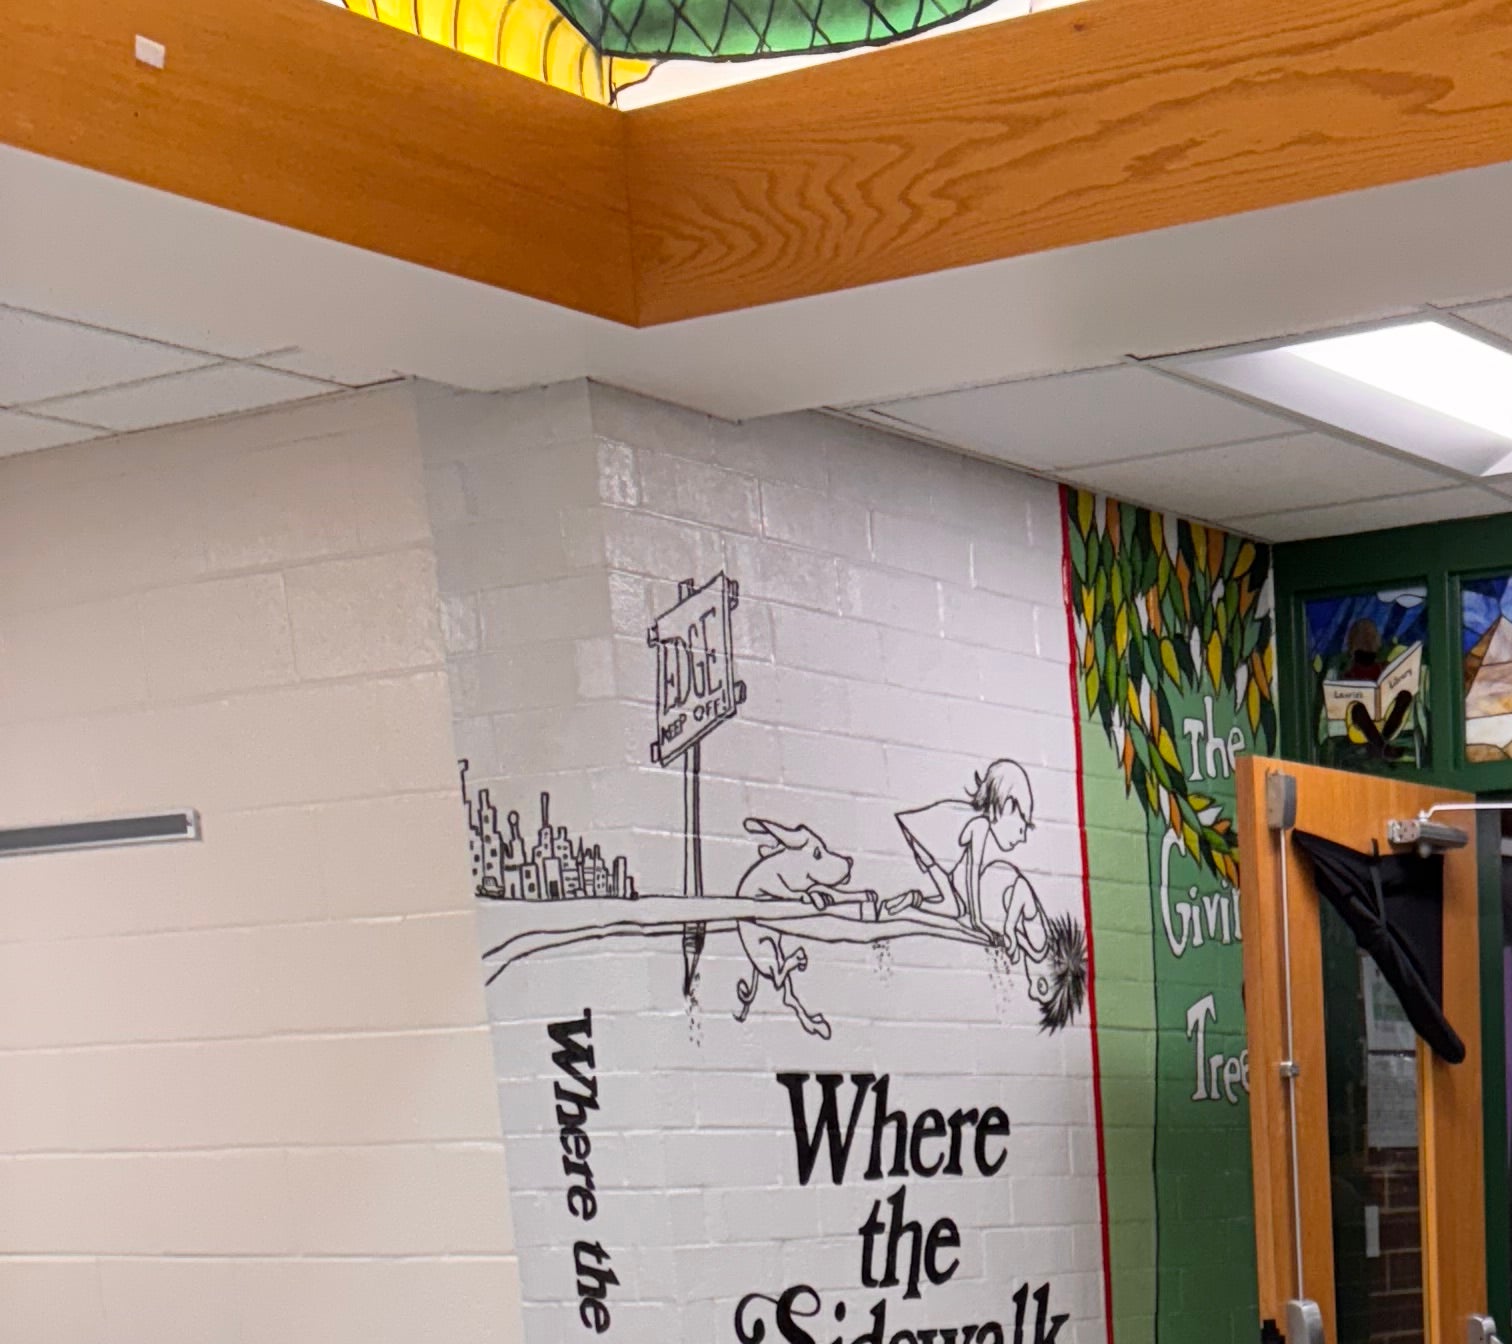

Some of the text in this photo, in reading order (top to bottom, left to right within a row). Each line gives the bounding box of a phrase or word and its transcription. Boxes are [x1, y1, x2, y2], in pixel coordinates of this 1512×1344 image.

[659, 606, 723, 716] EDGE
[1183, 695, 1245, 783] The
[1160, 826, 1243, 959] Givi
[547, 1008, 600, 1222] Where
[776, 1071, 1010, 1186] Where
[573, 1240, 620, 1334] the
[858, 1186, 962, 1299] the
